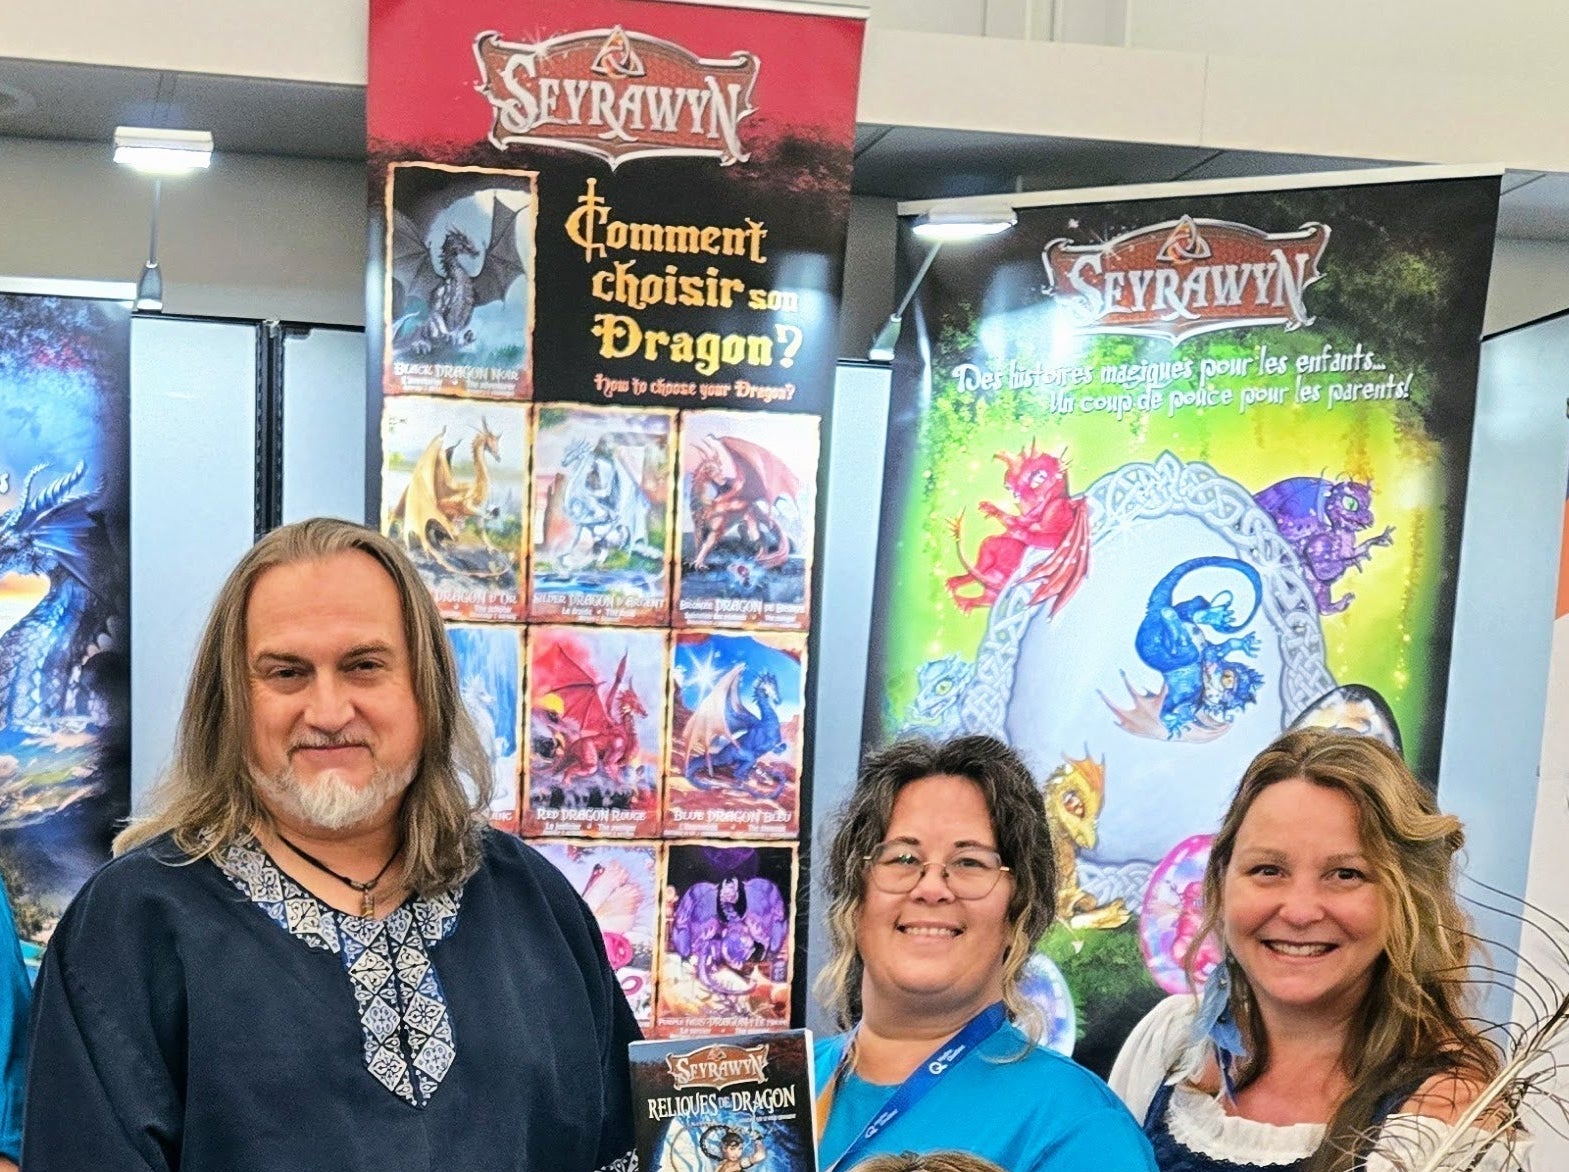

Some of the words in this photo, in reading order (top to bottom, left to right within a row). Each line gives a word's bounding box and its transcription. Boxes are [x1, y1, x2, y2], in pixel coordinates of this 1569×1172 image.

[500, 54, 751, 162] SEYRAWYN
[565, 178, 768, 263] Comment
[592, 260, 745, 310] choisir
[748, 288, 798, 312] son
[1062, 249, 1316, 326] SEYRAWYN
[591, 313, 803, 376] Dragon?
[435, 364, 488, 379] DRAGON
[594, 373, 629, 398] How
[632, 377, 648, 395] to
[651, 377, 696, 397] choose
[699, 382, 731, 399] your
[733, 379, 796, 403] Dragon?
[953, 363, 1002, 392] Des
[1009, 360, 1094, 390] histoires
[1100, 358, 1193, 390] magiques
[1201, 358, 1253, 387] pour
[1258, 345, 1288, 375] les
[1295, 343, 1387, 375] enfants...
[1050, 389, 1074, 414] Un
[1080, 393, 1132, 421] coup
[1136, 388, 1163, 412] de
[1168, 387, 1233, 417] pouce
[1240, 386, 1289, 414] pour
[1295, 375, 1321, 404] les
[1327, 373, 1413, 410] parents!
[714, 599, 762, 613] DRAGON
[536, 808, 557, 820] RED
[560, 808, 608, 821] DRAGON
[673, 808, 704, 821] BLUE
[707, 808, 760, 823] DRAGON
[675, 1053, 769, 1084] SEYRAWYN
[648, 1091, 718, 1121] RELIQUES
[718, 1096, 731, 1109] DE
[731, 1085, 796, 1114] DRAGON
